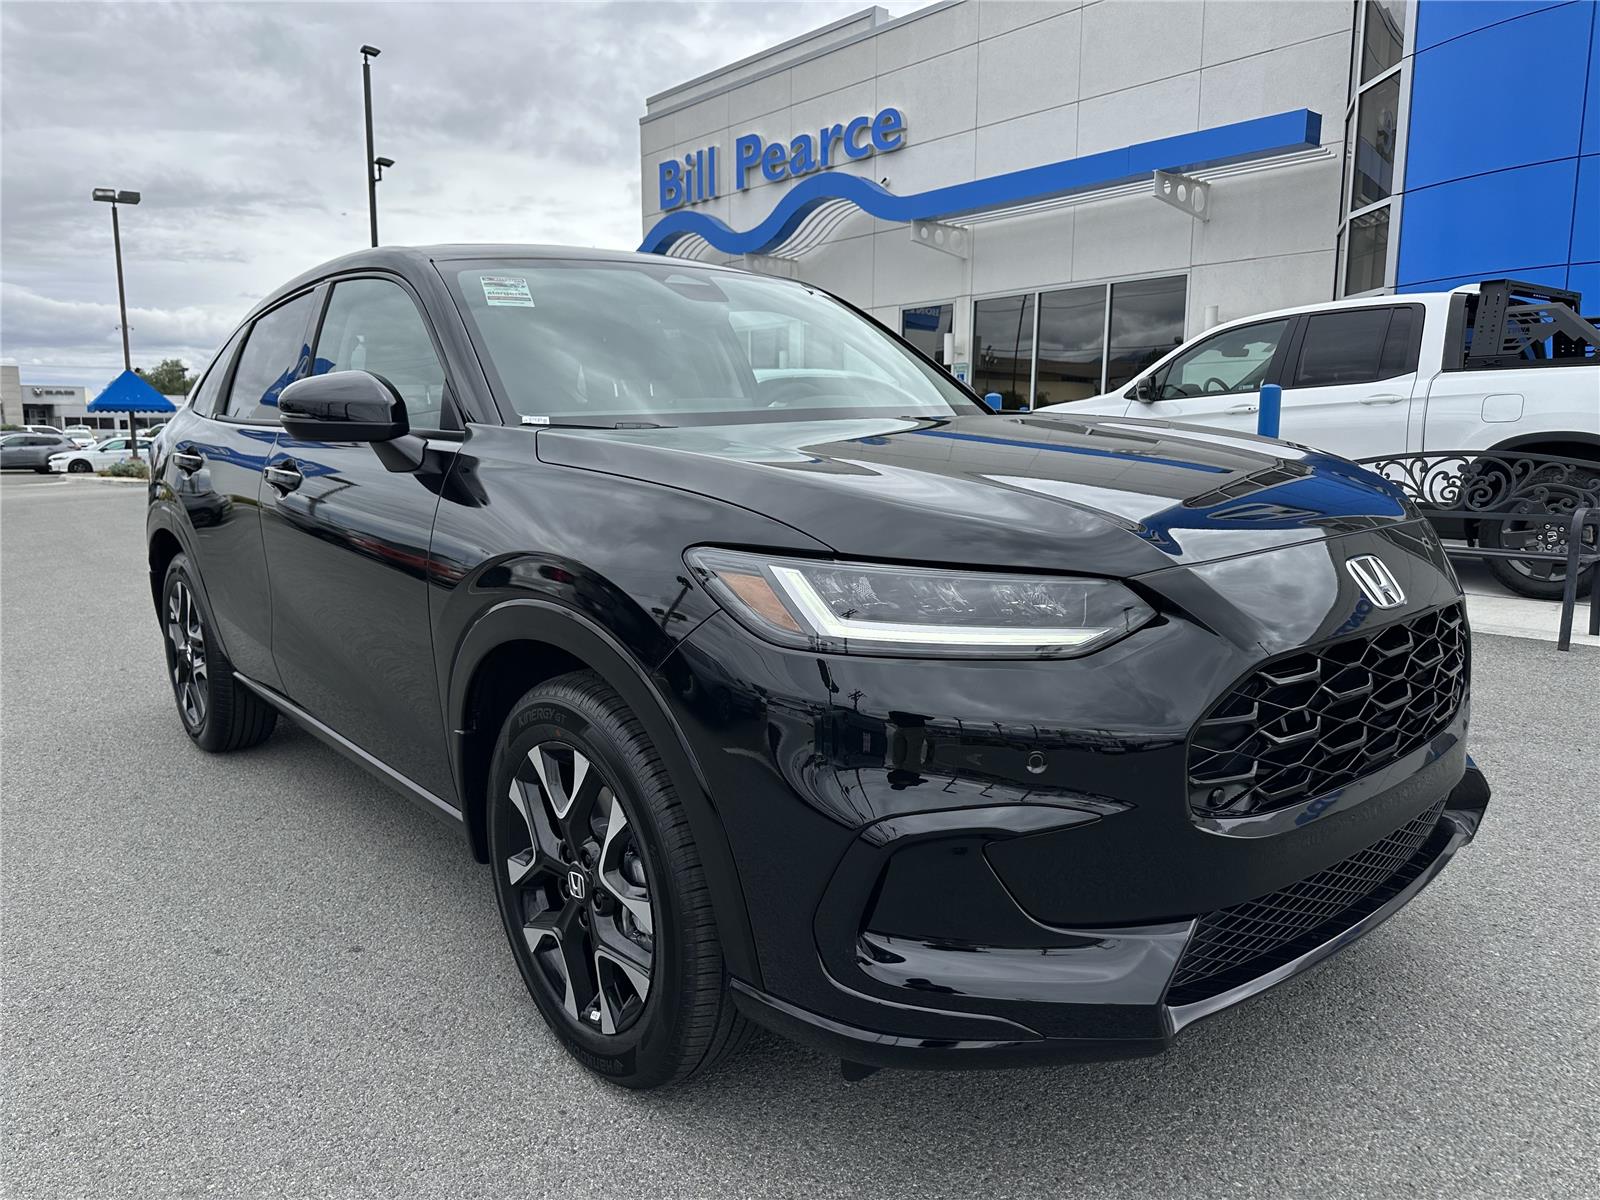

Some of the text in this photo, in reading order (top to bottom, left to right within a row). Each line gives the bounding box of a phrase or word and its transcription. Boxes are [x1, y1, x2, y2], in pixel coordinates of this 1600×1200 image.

[658, 107, 905, 211] Bill Pearce
[554, 712, 567, 723] GT
